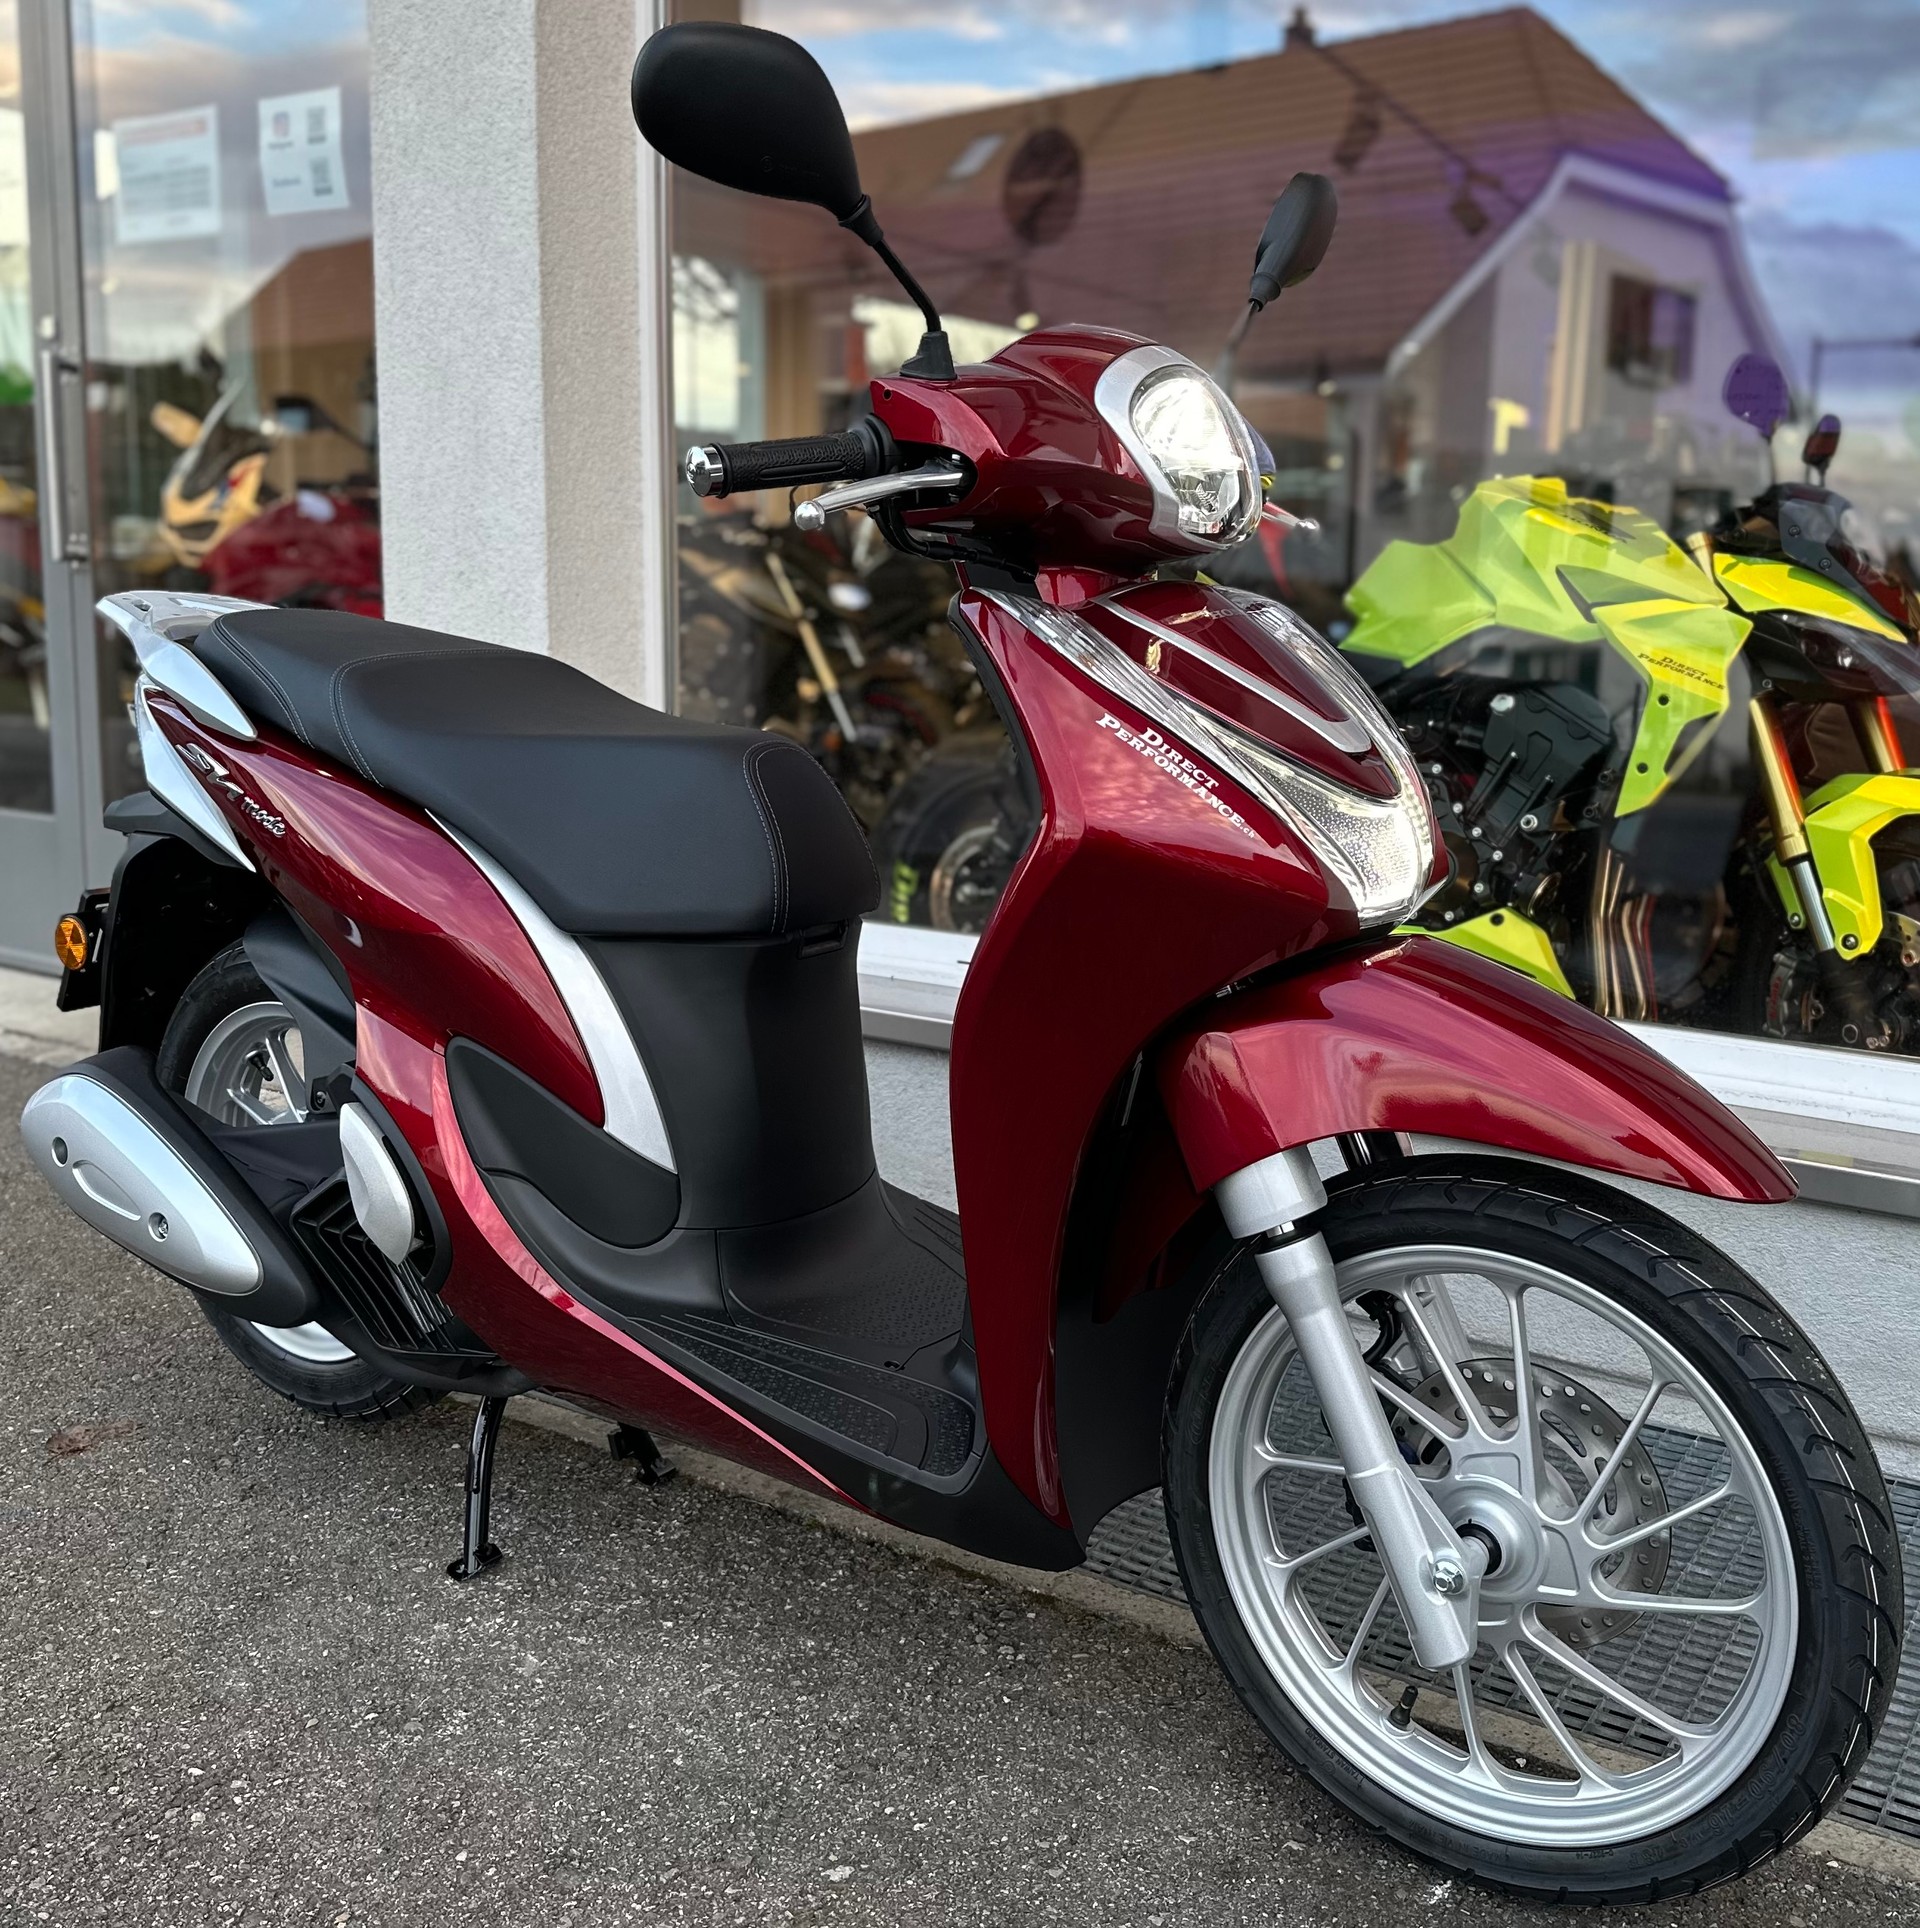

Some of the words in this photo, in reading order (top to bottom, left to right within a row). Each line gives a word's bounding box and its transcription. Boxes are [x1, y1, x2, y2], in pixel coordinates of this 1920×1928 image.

[1636, 652, 1725, 690] PERFORMANCE
[1660, 655, 1708, 677] DIRECT
[1137, 726, 1219, 791] DIRECT
